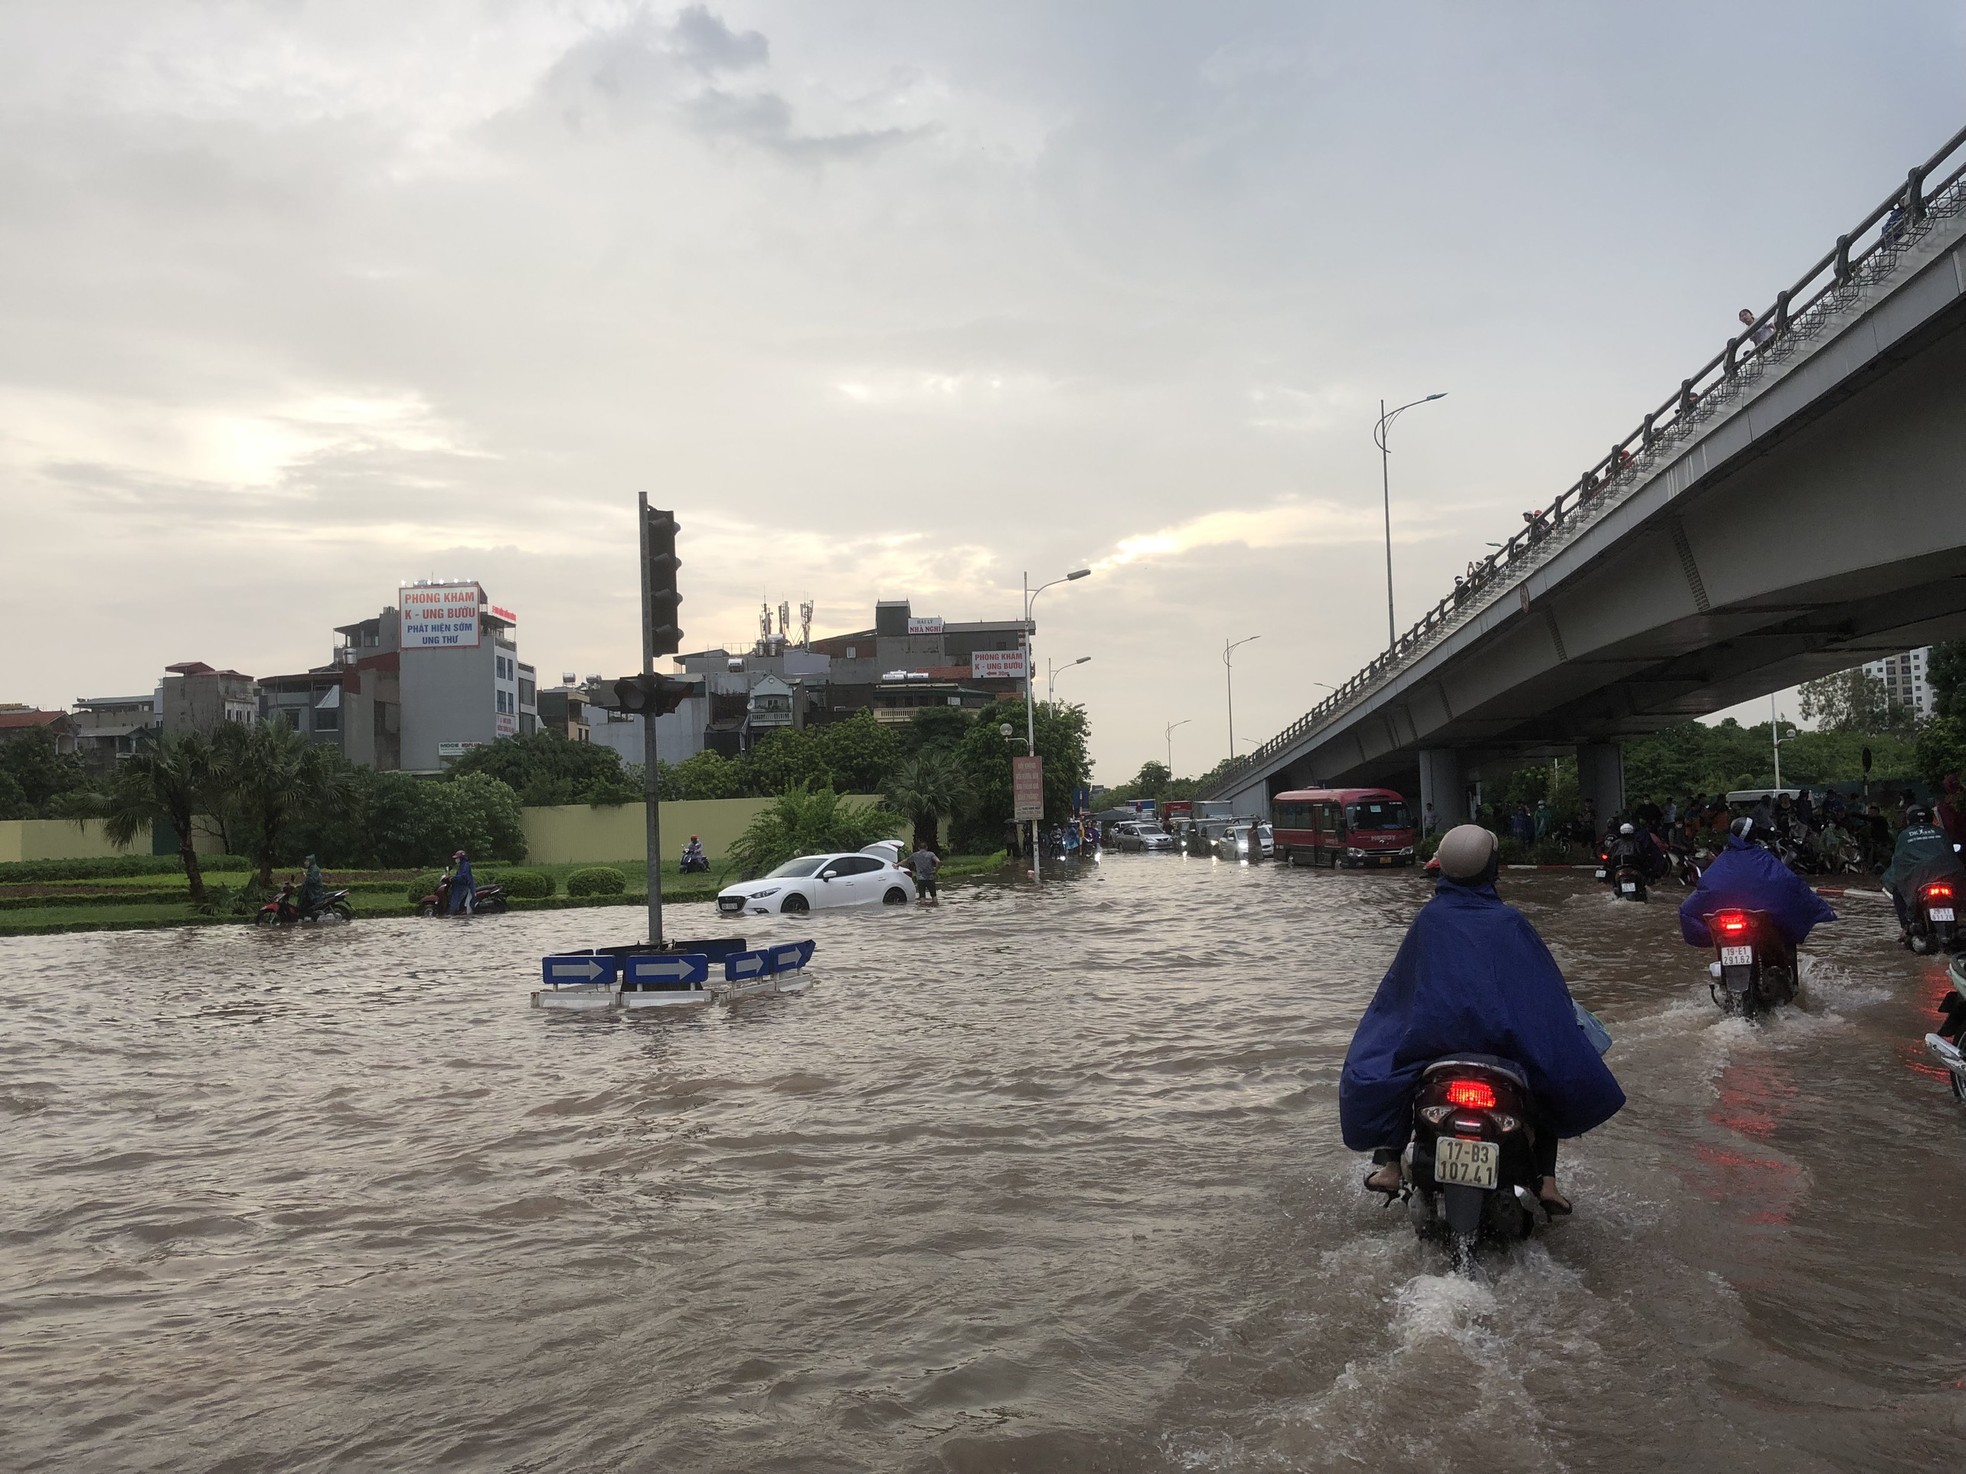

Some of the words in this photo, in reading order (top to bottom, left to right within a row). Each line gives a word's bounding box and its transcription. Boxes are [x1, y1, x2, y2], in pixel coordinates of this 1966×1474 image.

[405, 610, 412, 620] K
[1724, 955, 1750, 965] 291.62
[1447, 1142, 1489, 1164] 17-B3
[1440, 1160, 1493, 1186] 107.41
